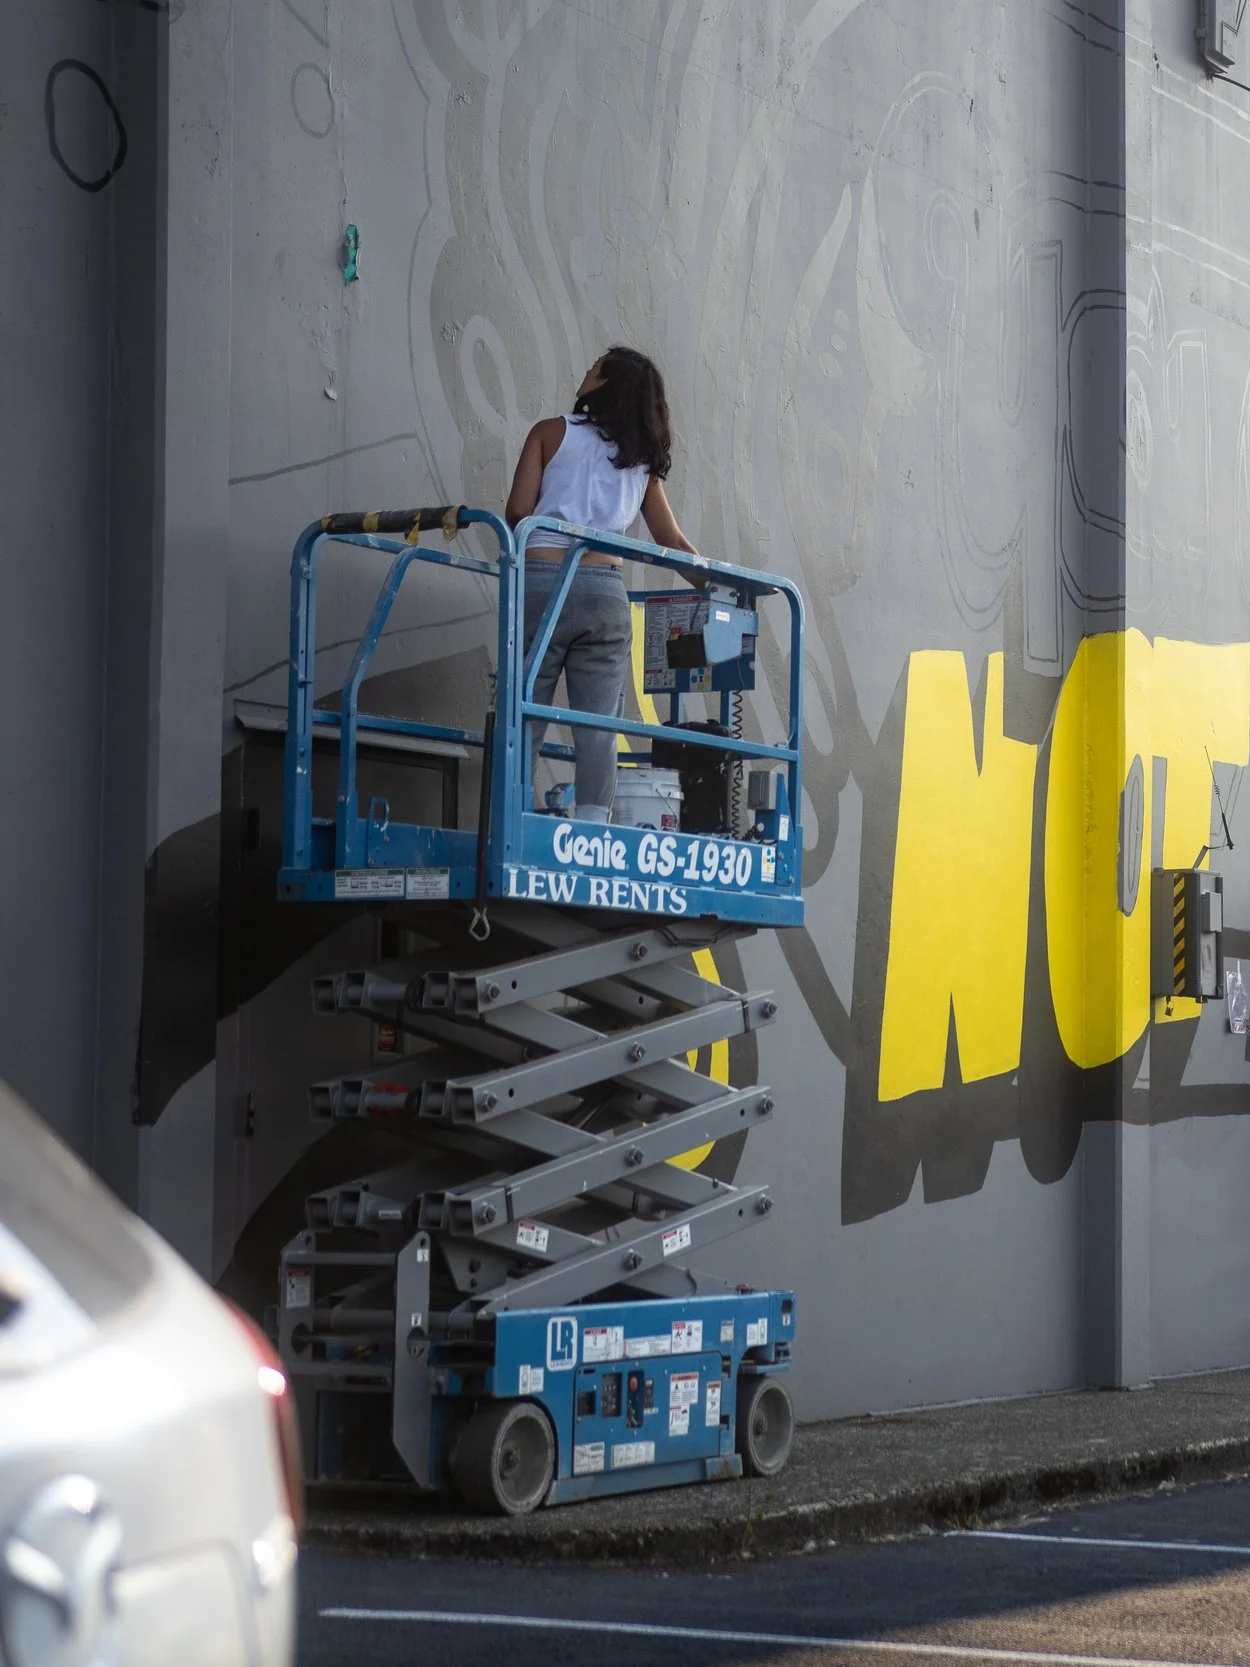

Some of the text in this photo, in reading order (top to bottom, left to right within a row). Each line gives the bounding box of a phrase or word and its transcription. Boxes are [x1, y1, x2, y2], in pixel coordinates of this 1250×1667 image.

[553, 823, 752, 887] Genie GS-1930
[507, 868, 688, 915] LEW RENTS
